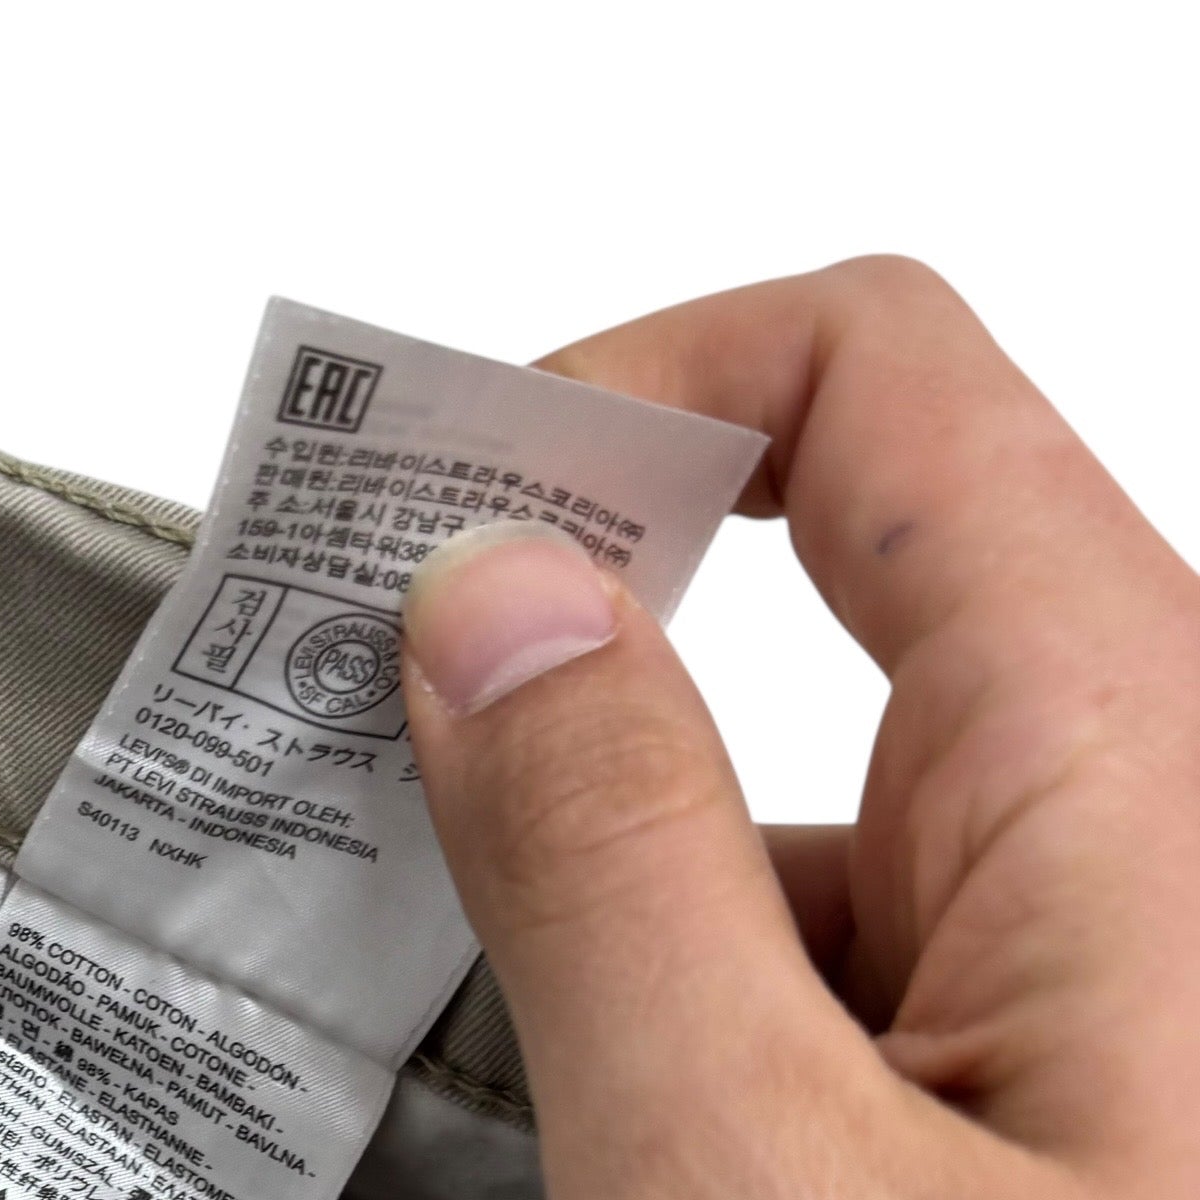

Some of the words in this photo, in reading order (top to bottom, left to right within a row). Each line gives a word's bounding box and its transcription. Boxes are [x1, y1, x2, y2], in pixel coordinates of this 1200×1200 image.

[289, 356, 372, 424] EAC
[300, 686, 322, 706] SF
[318, 649, 376, 685] PASS
[132, 705, 274, 778] 0120-099-501
[93, 772, 179, 820] JAKARTA
[188, 816, 300, 860] INDONESIA
[104, 753, 135, 775] PT
[131, 765, 177, 794] LEVI
[174, 785, 271, 829] STRAUSS
[269, 817, 383, 863] INDONESIA
[188, 765, 213, 786] DI
[210, 776, 292, 812] IMPORT
[290, 799, 356, 829] OLEH:
[147, 838, 207, 873] NXHK
[6, 920, 47, 951] 98%
[46, 939, 123, 992] COTTON
[130, 985, 197, 1033] COTON
[205, 1027, 301, 1091] ALGODÓN
[94, 992, 162, 1039] PAMUK
[169, 1034, 249, 1088] COTONE
[74, 1055, 114, 1086] 98%
[121, 1081, 180, 1127] KAPAS
[111, 1026, 186, 1076] KATOEN
[195, 1072, 276, 1131] BAMBAKI
[52, 1110, 143, 1175] ELASTAAN
[95, 1089, 207, 1168] ELASTHANNE
[164, 1079, 227, 1126] PAMUT
[233, 1123, 309, 1175] BAVLNA
